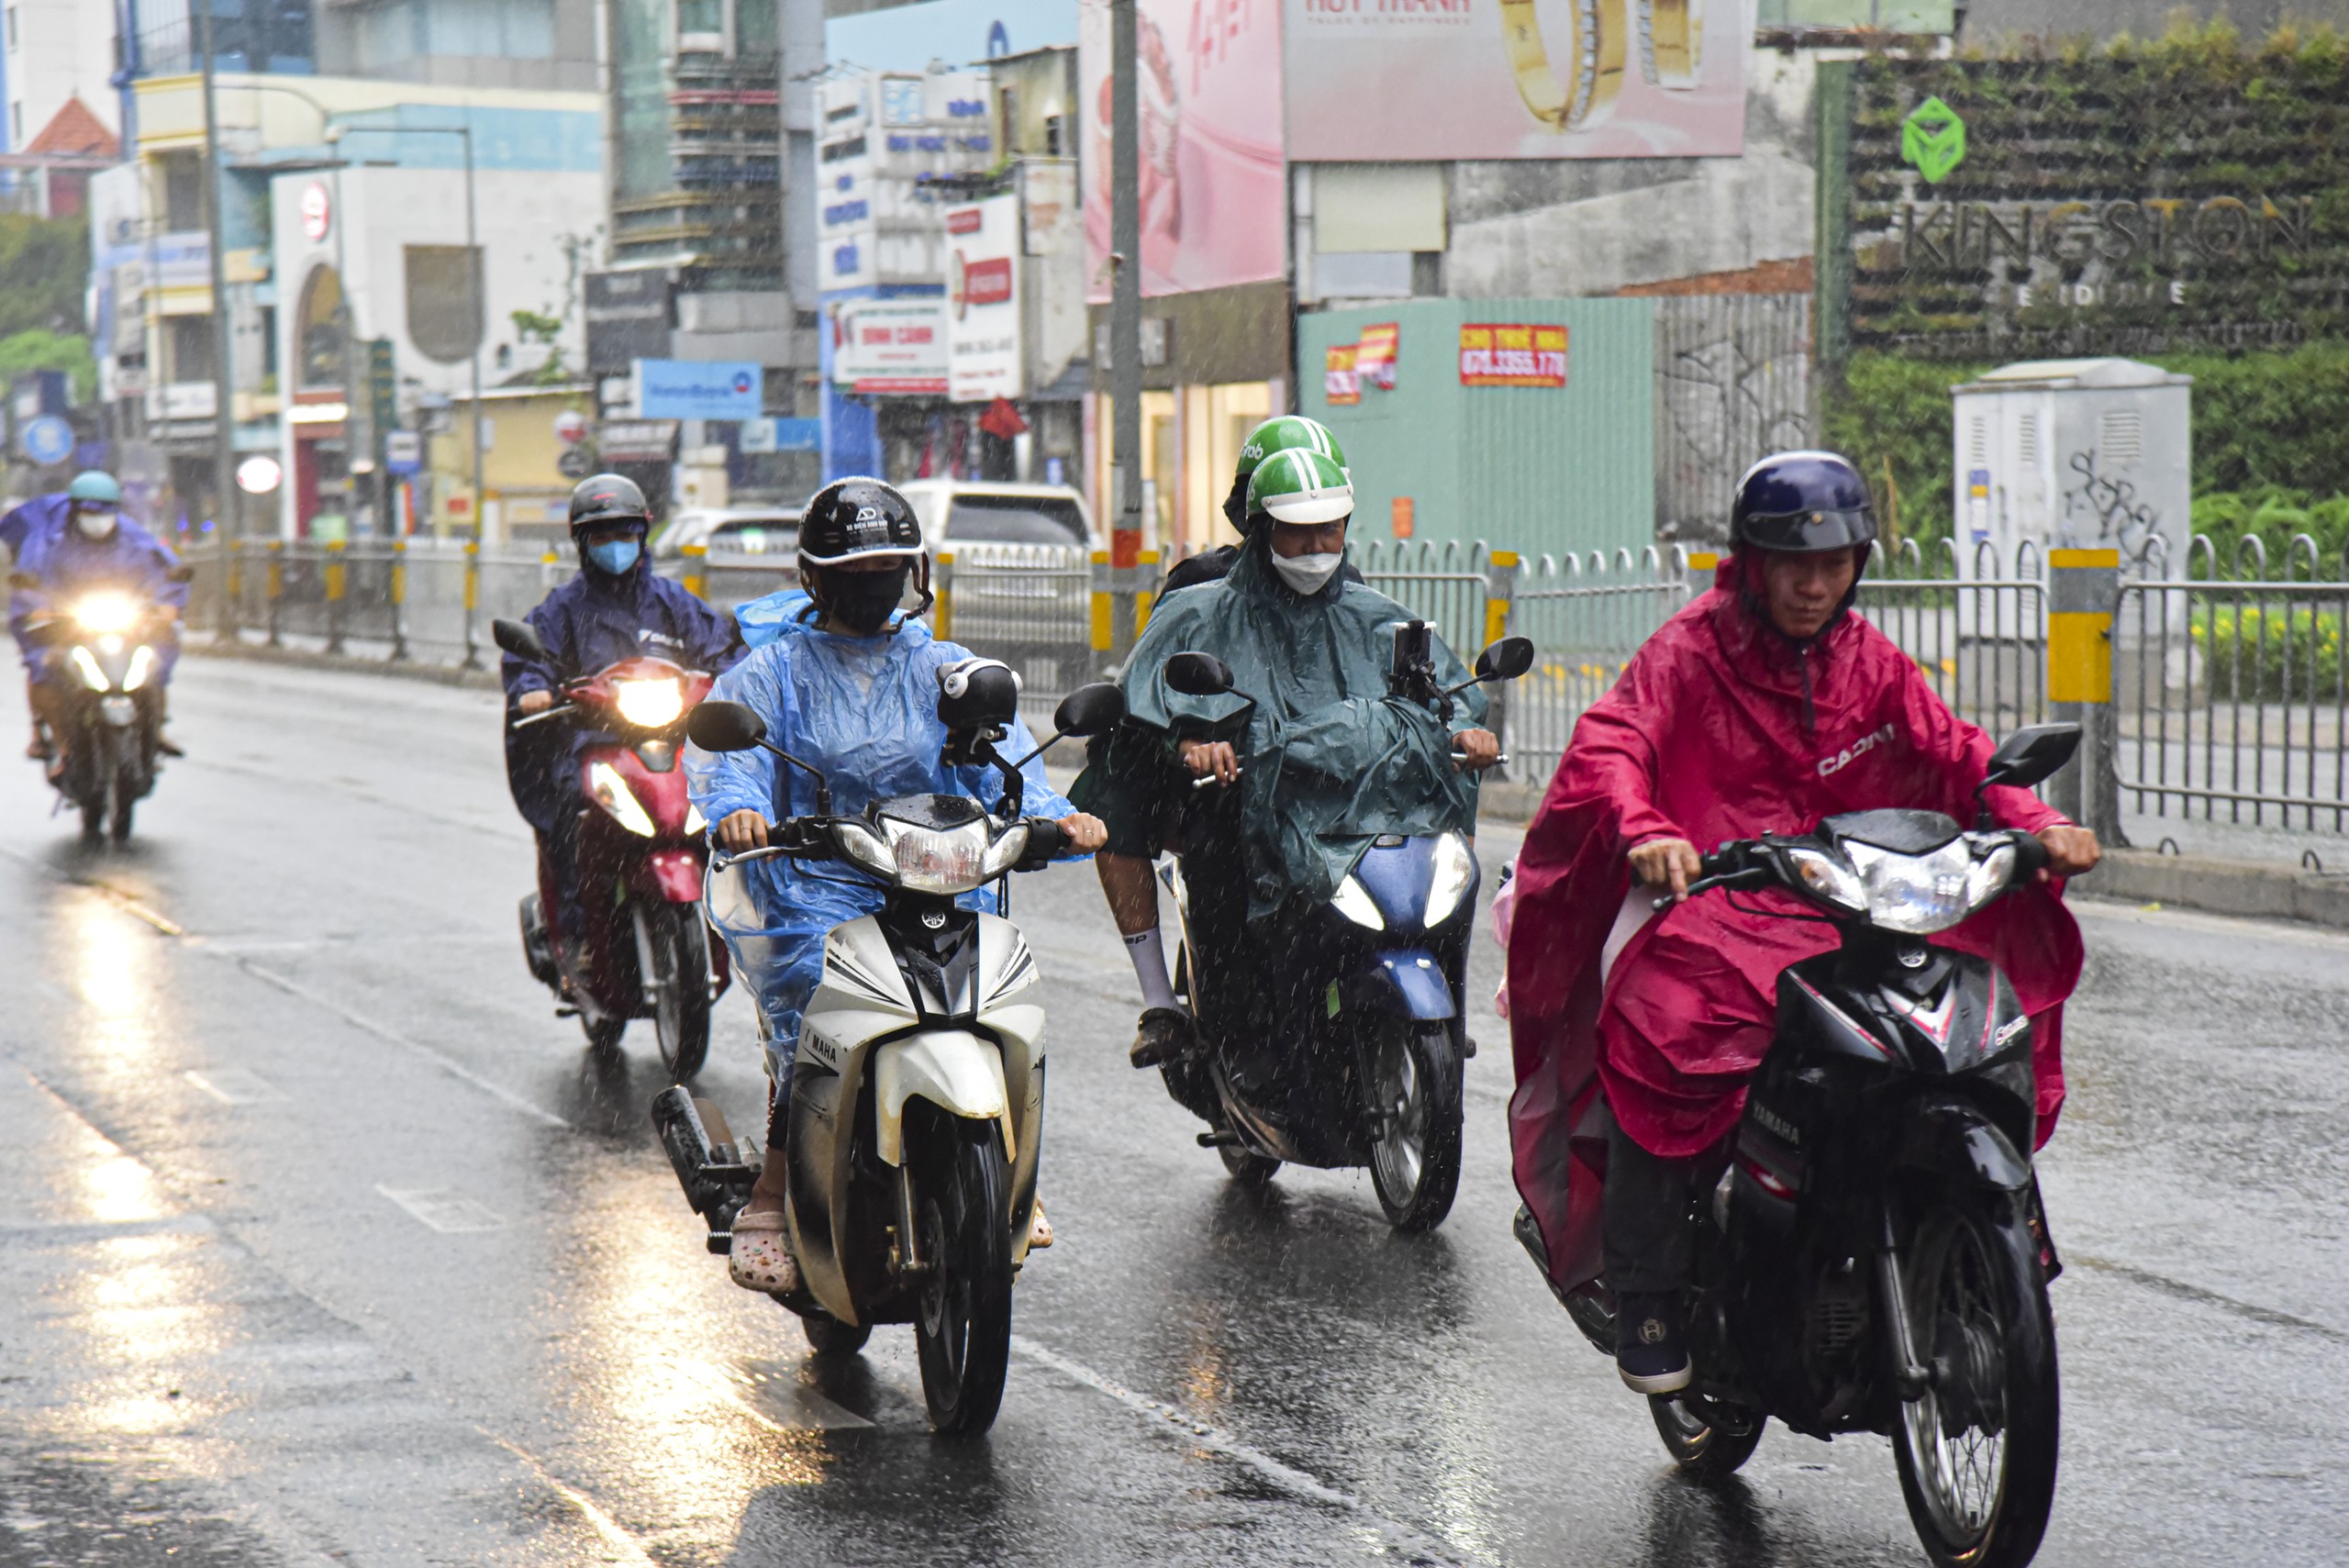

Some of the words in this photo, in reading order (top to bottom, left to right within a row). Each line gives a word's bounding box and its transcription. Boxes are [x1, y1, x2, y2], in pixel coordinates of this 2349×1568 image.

[1899, 194, 2313, 268] KINGSTON
[805, 1029, 836, 1063] MAHA
[1753, 1100, 1798, 1145] YAMAHA
